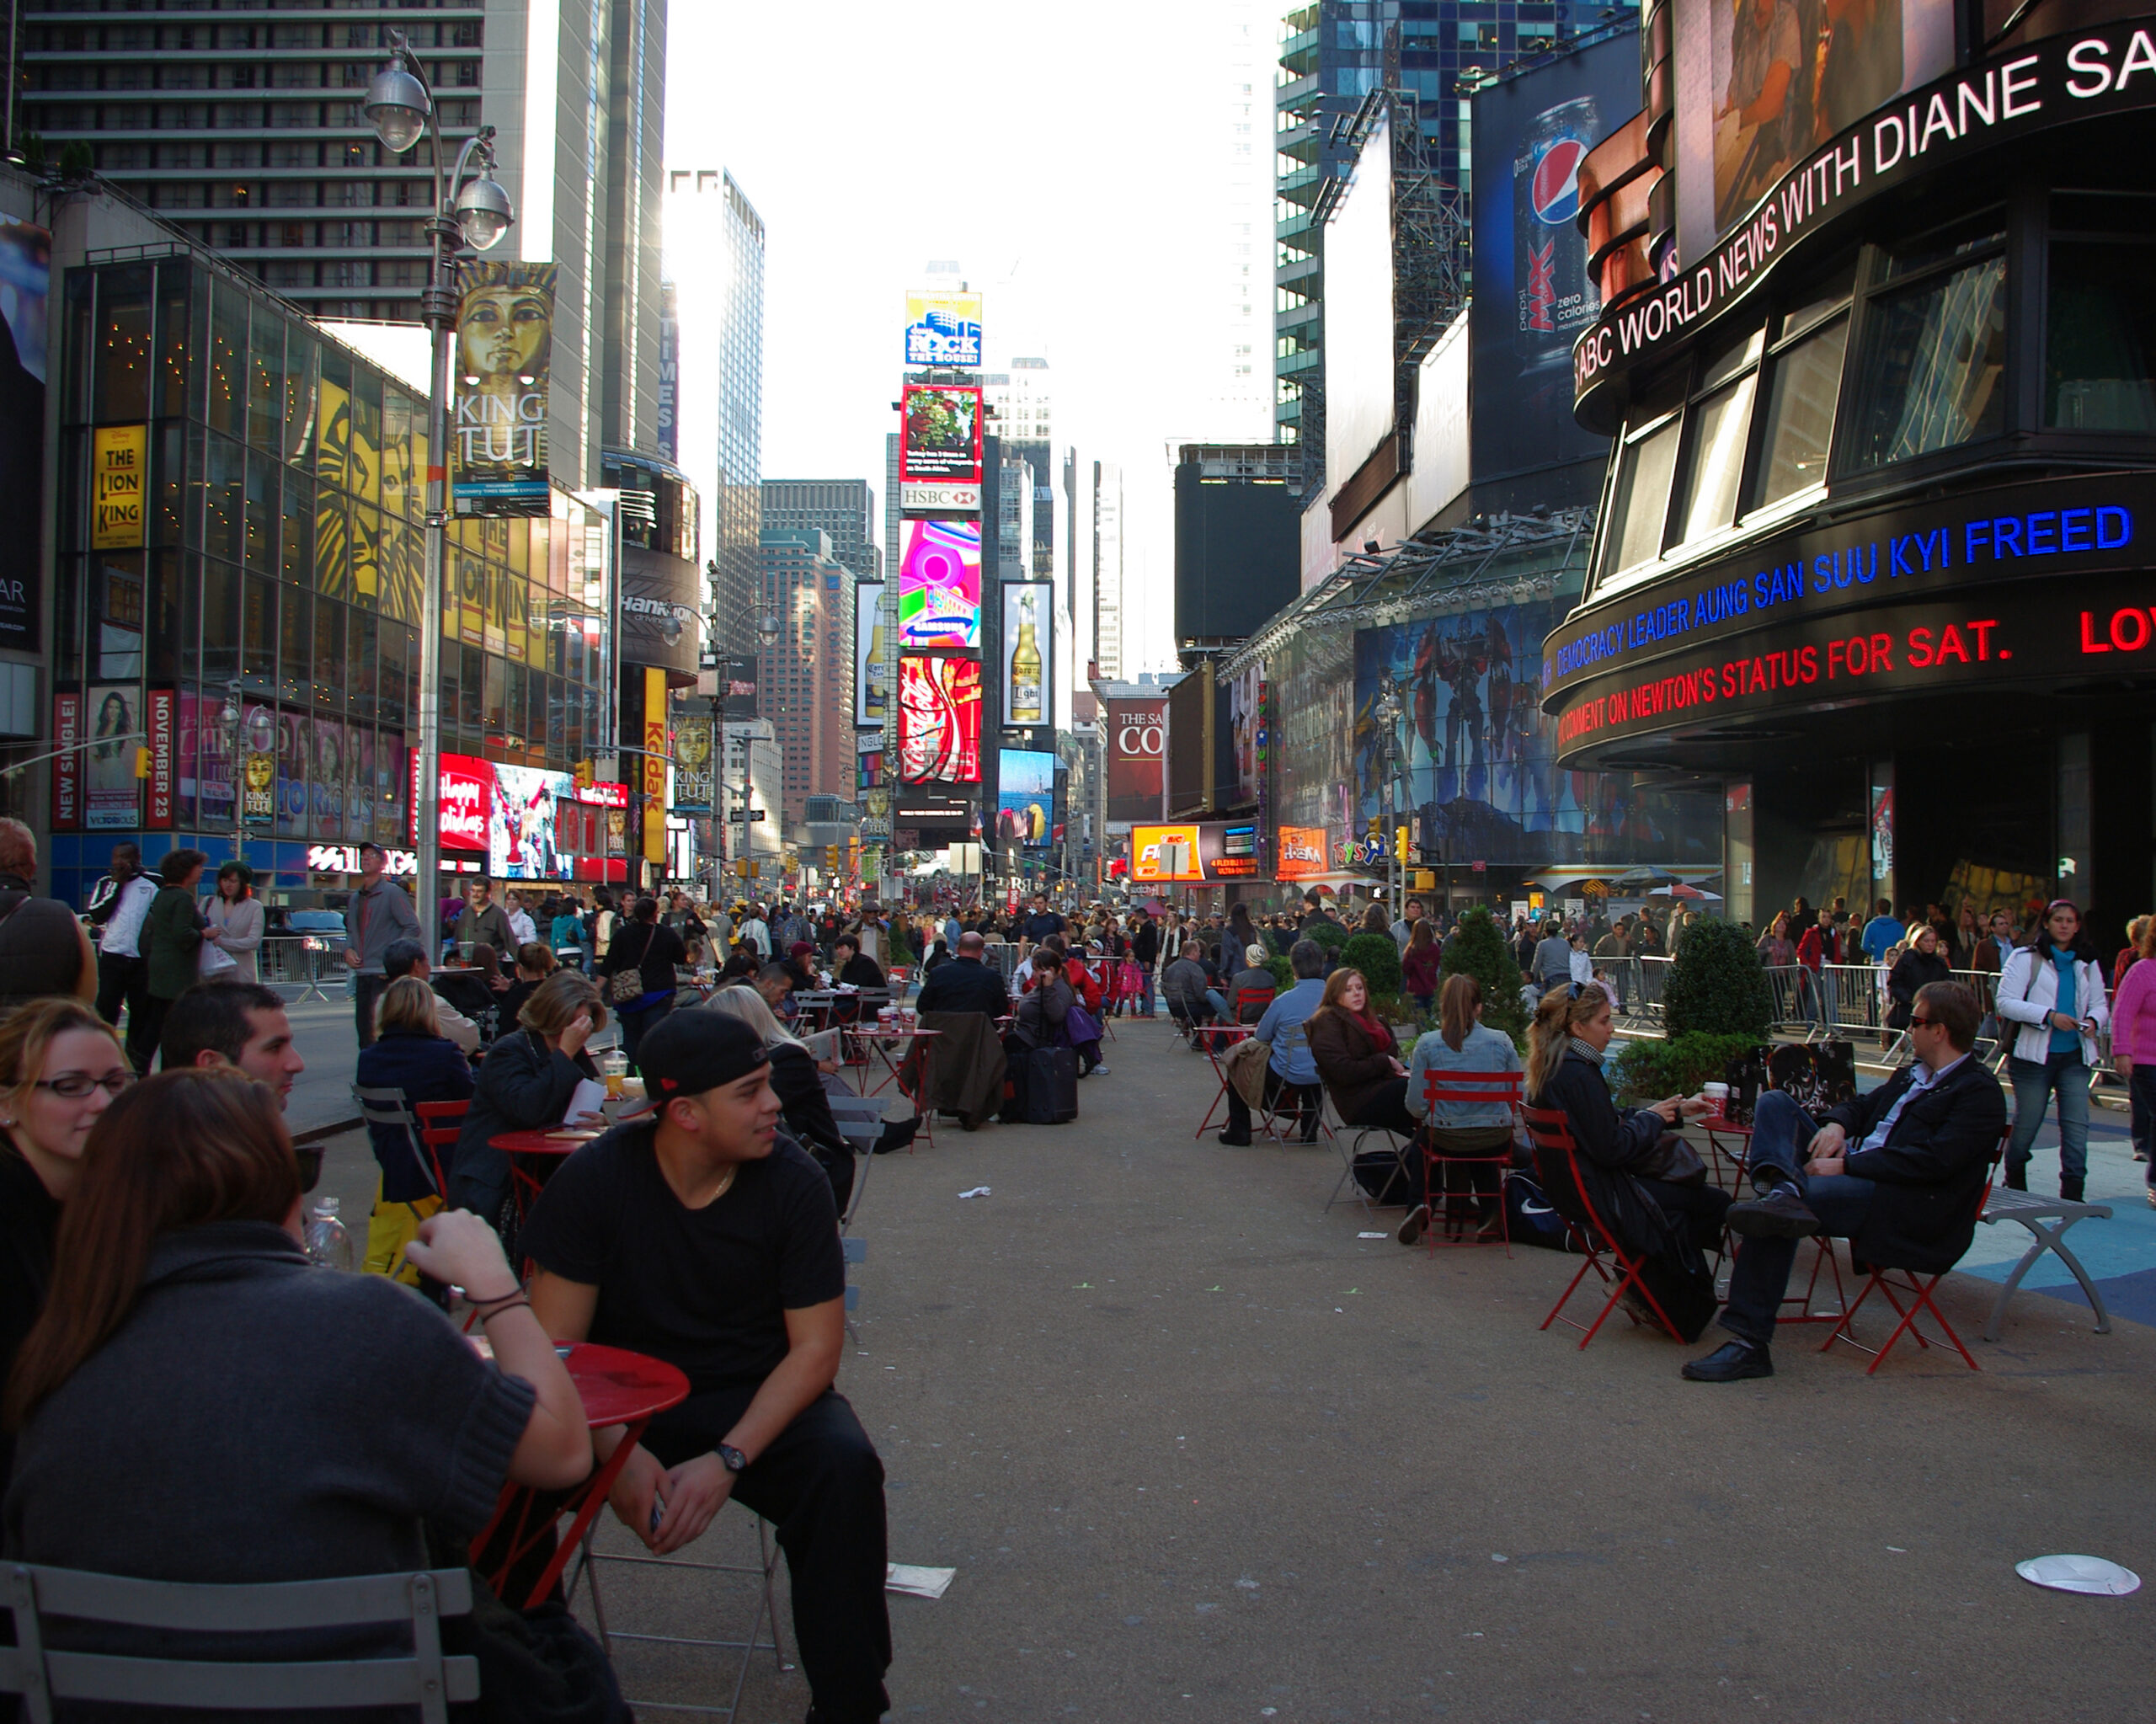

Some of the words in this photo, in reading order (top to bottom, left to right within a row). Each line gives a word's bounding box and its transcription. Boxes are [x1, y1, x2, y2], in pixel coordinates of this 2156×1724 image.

[1579, 327, 1613, 387] ABC
[1618, 265, 1713, 355] WORLD
[1719, 204, 1777, 297] NEWS
[1781, 136, 1860, 234] WITH
[1875, 55, 2041, 175] DIANE
[1519, 289, 1528, 331] pepsi
[1557, 293, 1581, 308] zero
[1557, 300, 1600, 322] calories
[658, 317, 676, 428] TIMES
[457, 393, 544, 424] KING
[106, 449, 134, 466] THE
[456, 424, 543, 462] TUT
[100, 472, 138, 501] LION
[904, 490, 950, 504] HSBC
[99, 504, 139, 533] KING
[1557, 621, 1625, 677] DEMOCRACY
[1628, 598, 1690, 649] LEADER
[1694, 579, 1749, 627] AUNG
[1754, 561, 1804, 610] SAN
[1813, 542, 1878, 593] SUU
[1889, 526, 1951, 578] KYI
[1965, 505, 2133, 564] FREED
[1608, 691, 1628, 725] ON
[1631, 667, 1716, 719] NEWTON'S
[1722, 645, 1817, 698] STATUS
[1827, 632, 1894, 678] FOR
[1907, 618, 2012, 668] SAT.
[1118, 713, 1146, 724] THE
[61, 700, 75, 773] SINGLE!
[155, 696, 168, 793] NOVEMBER
[647, 722, 664, 814] Kodak
[675, 771, 710, 783] KING
[60, 777, 74, 819] NEW
[246, 792, 270, 800] KING
[246, 800, 270, 811] TUT
[440, 773, 480, 808] Happy
[676, 783, 708, 798] TUT
[155, 798, 168, 818] 23
[440, 805, 501, 840] olidays
[870, 825, 888, 833] TUT
